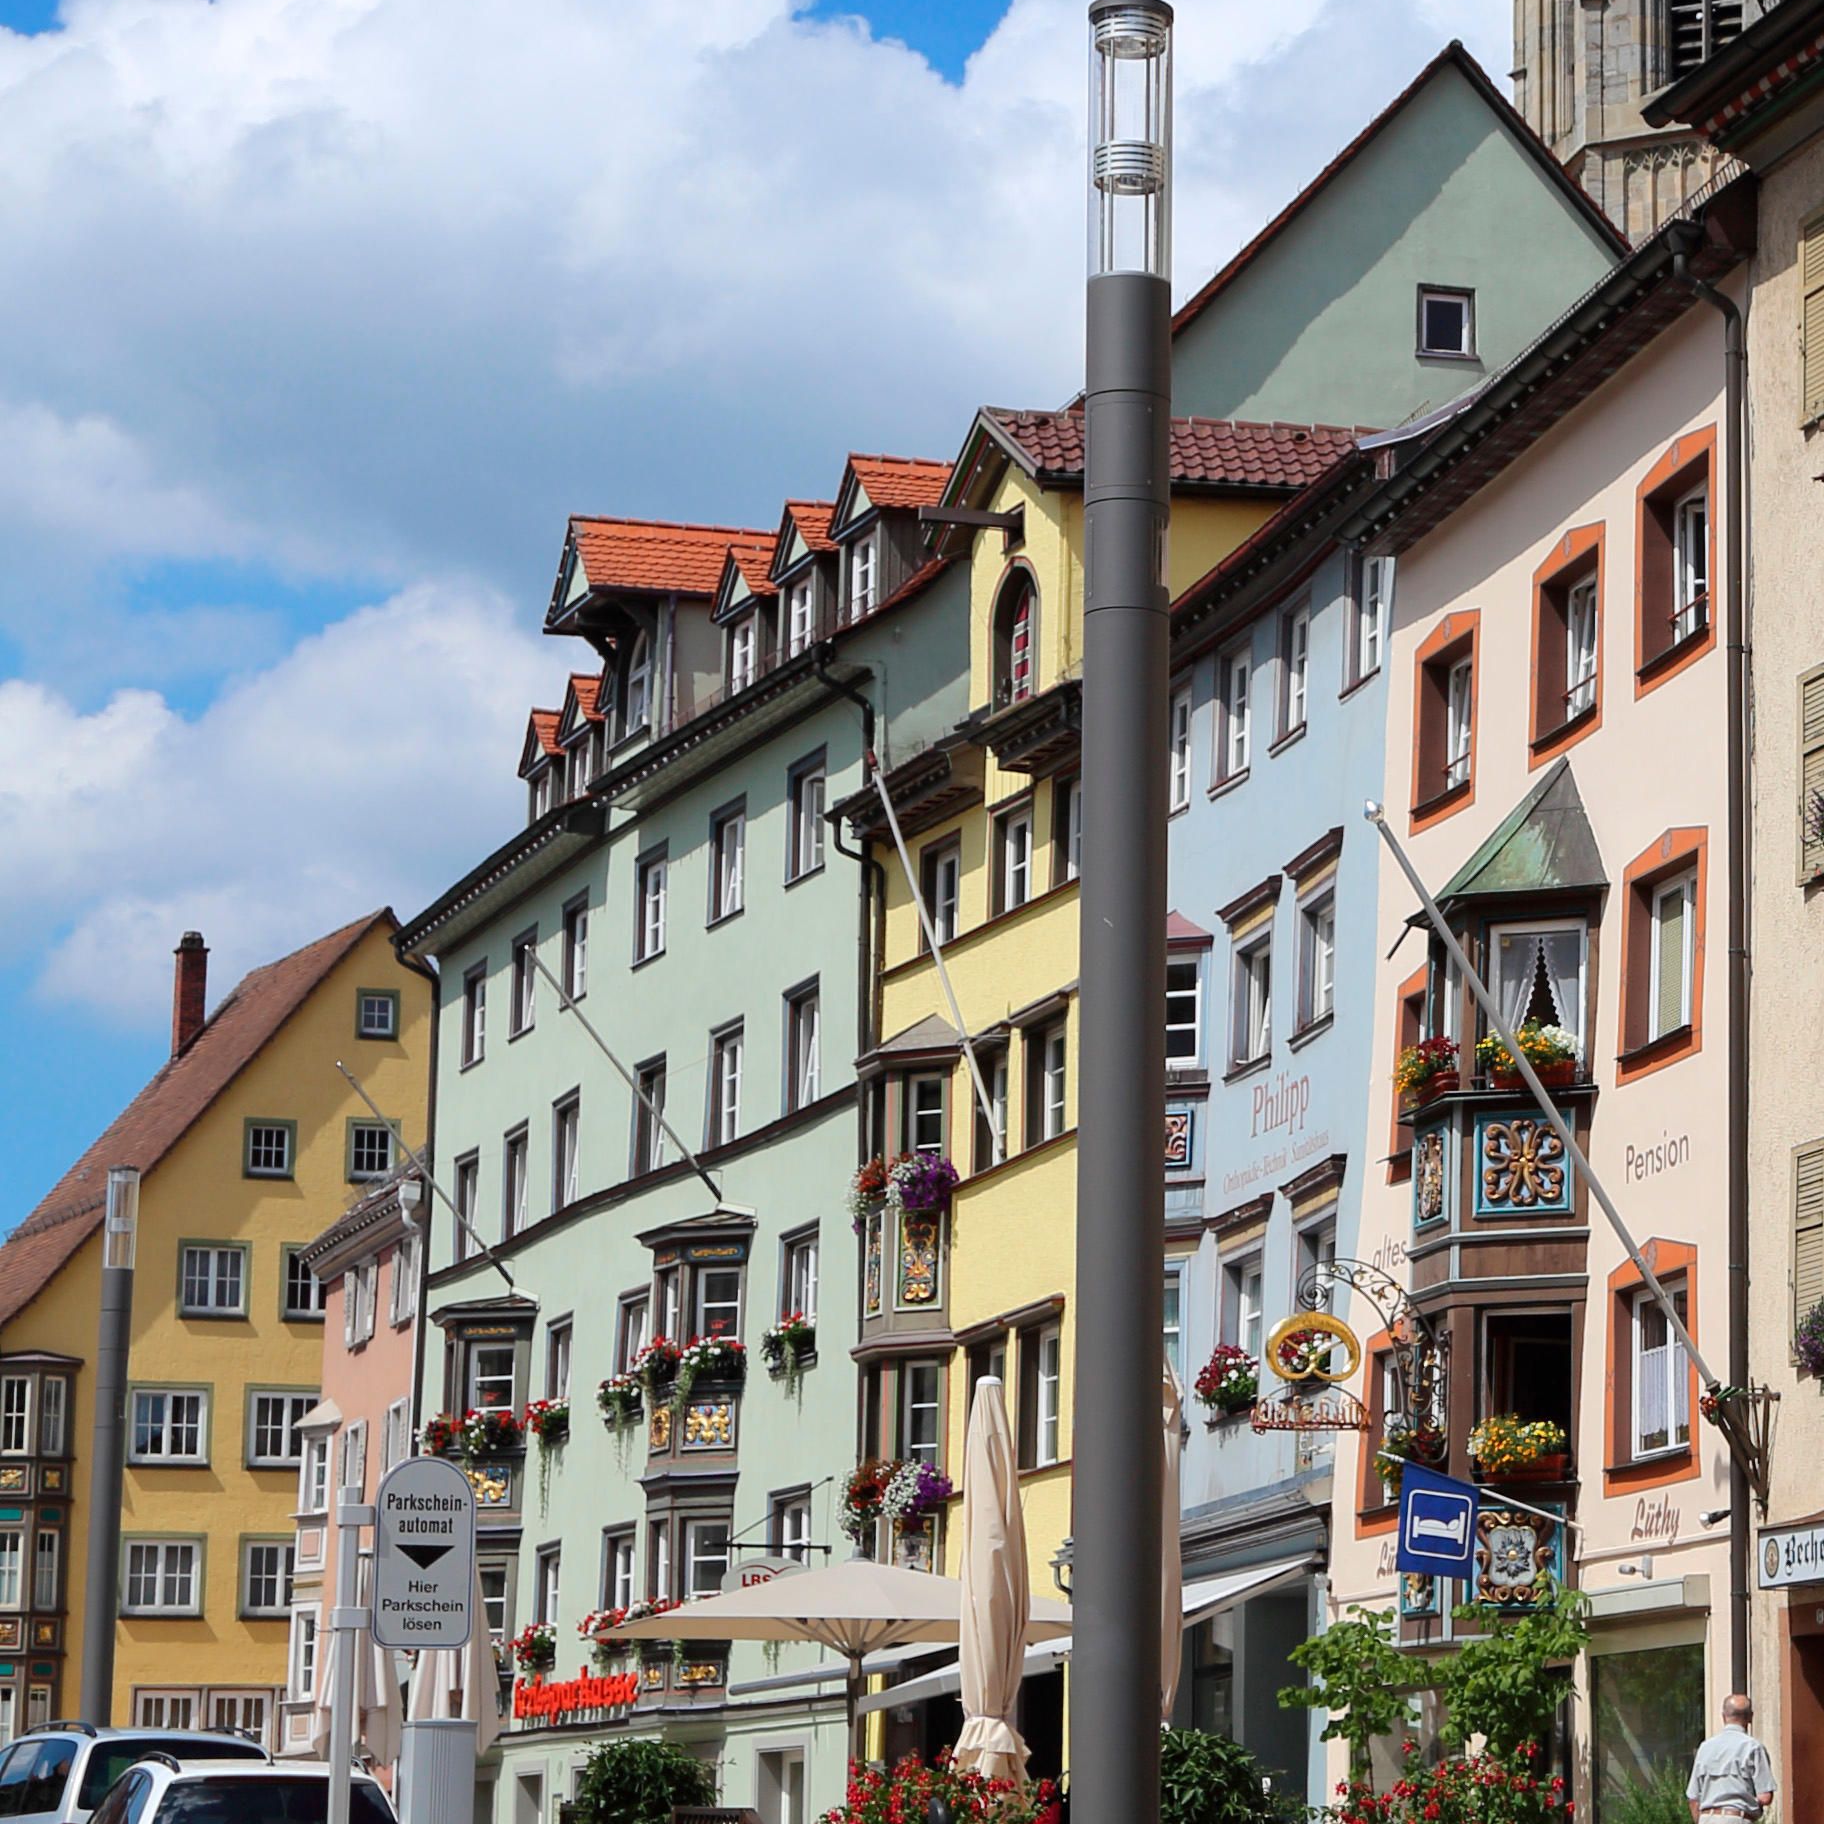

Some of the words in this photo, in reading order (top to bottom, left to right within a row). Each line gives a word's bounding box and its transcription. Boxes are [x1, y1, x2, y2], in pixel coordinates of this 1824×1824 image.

[1251, 1071, 1310, 1138] Philipp
[1625, 1129, 1690, 1184] Pension
[387, 1493, 468, 1512] Parkschein-
[399, 1517, 453, 1534] automat
[1631, 1492, 1680, 1546] Lüthy
[408, 1580, 439, 1594] Hier
[382, 1598, 464, 1613] Parkschein
[402, 1617, 442, 1631] lösen
